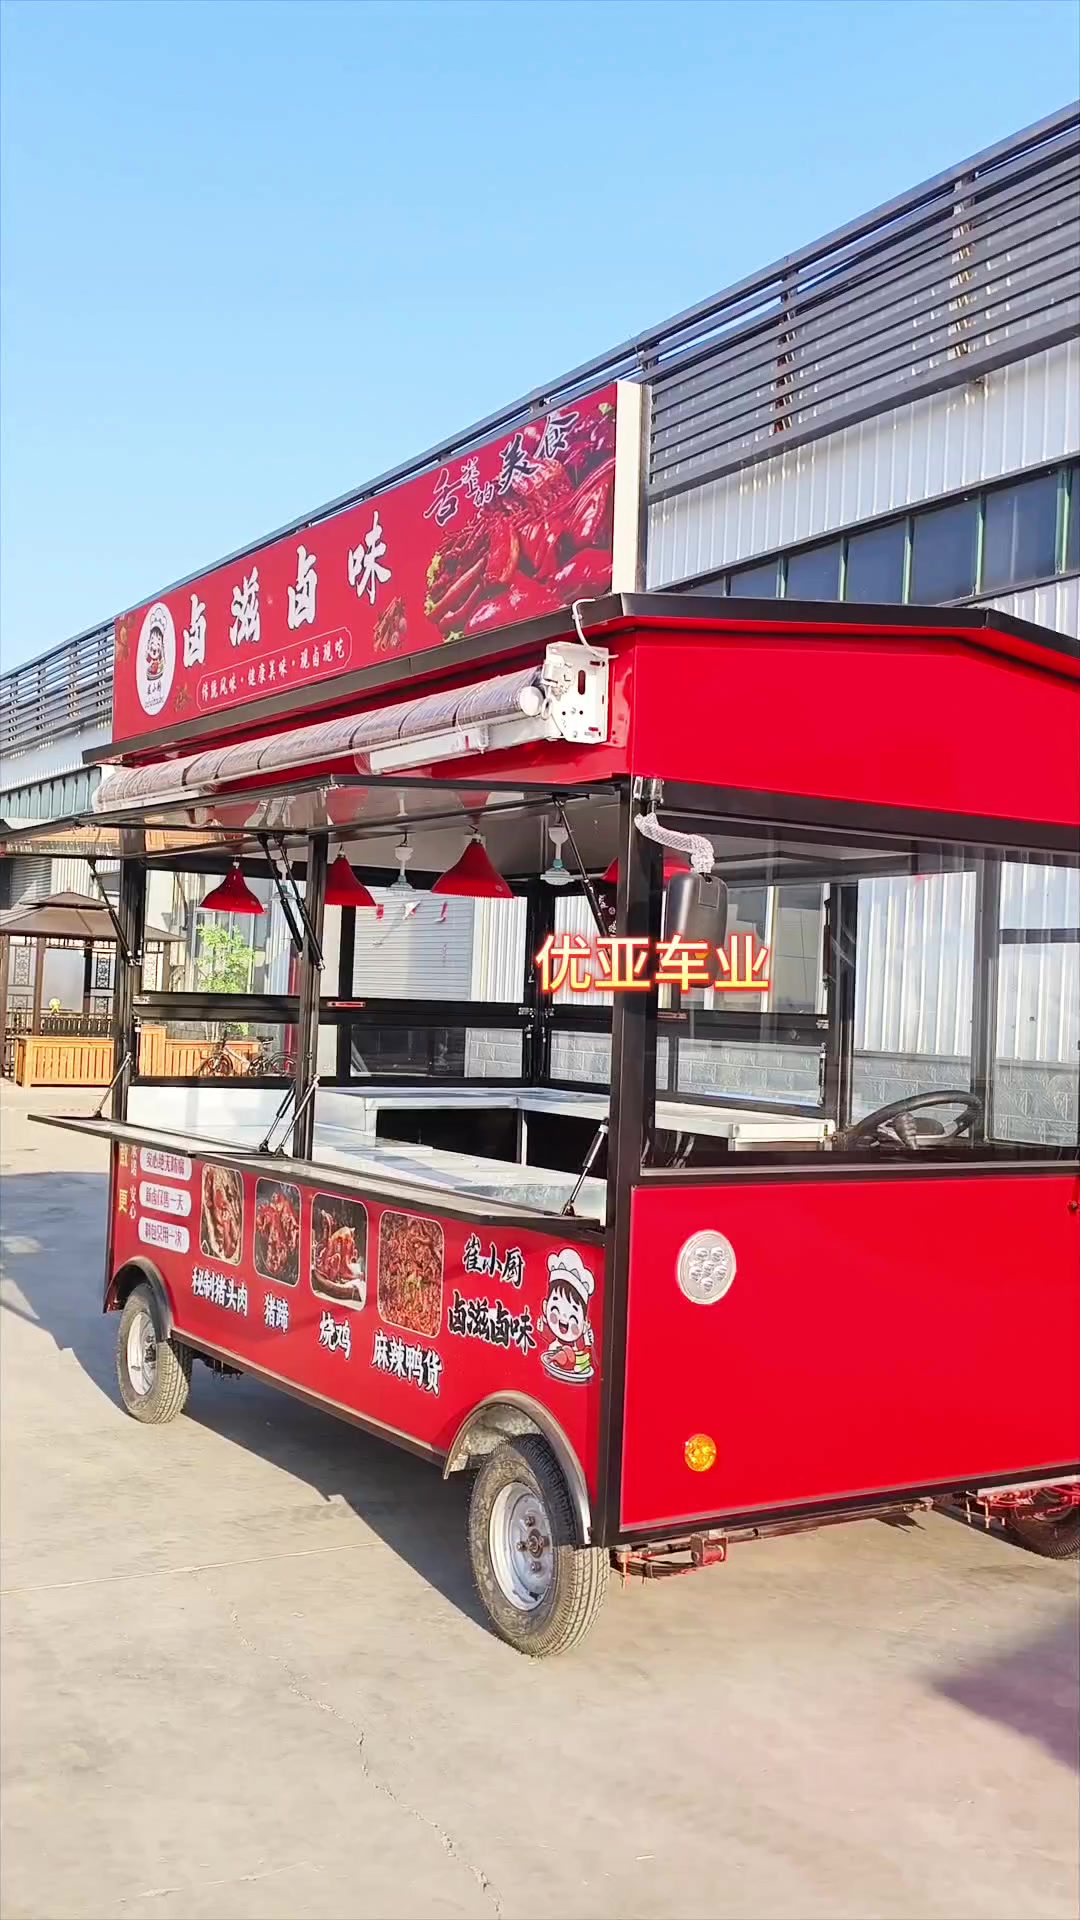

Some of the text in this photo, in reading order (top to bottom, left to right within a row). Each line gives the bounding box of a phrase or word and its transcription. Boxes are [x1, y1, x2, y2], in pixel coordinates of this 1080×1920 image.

[183, 510, 392, 668] 卤滋卤味
[462, 1232, 526, 1289] 崔小厨
[191, 1266, 249, 1317] 秘制猪头肉
[263, 1290, 290, 1337] 猪蹄
[318, 1310, 352, 1361] 烧鸡
[447, 1288, 537, 1356] 卤滋卤味
[369, 1327, 444, 1398] 麻辣鸭货
